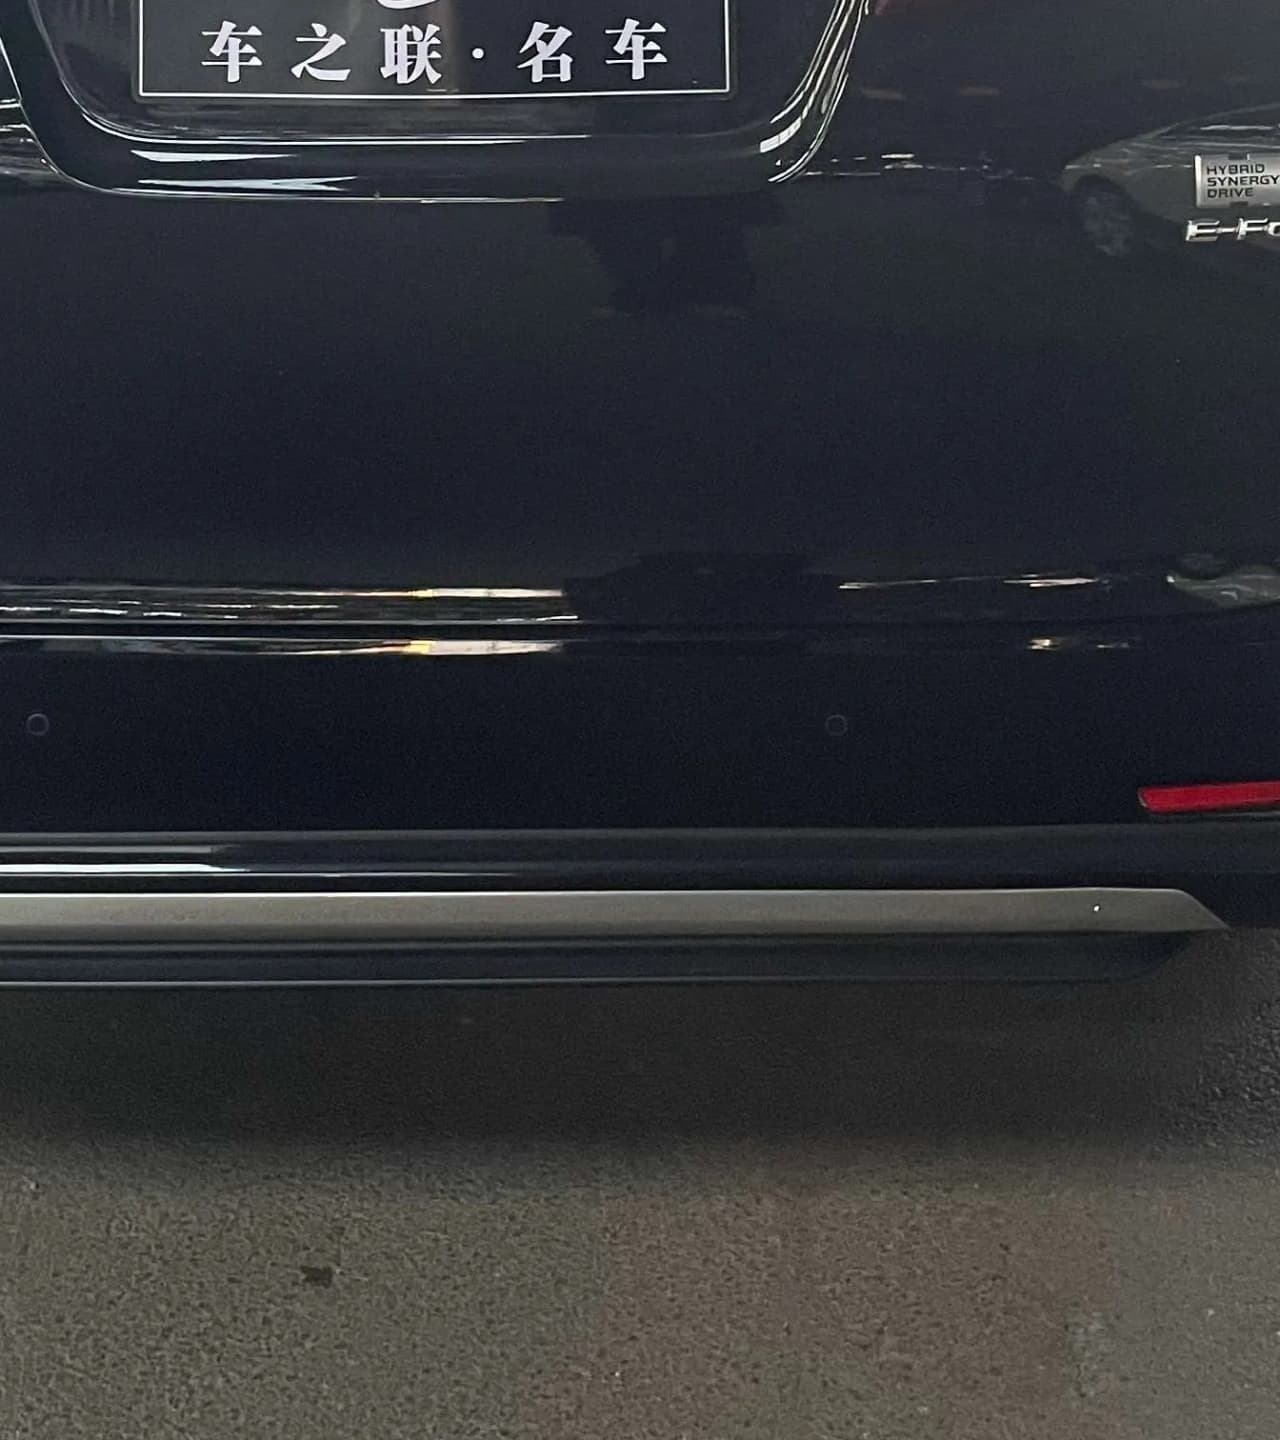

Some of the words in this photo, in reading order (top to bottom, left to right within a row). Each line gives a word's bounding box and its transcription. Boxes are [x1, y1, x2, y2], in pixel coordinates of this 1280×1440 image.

[1206, 163, 1265, 175] HYBRID
[1207, 175, 1280, 187] SYNERGY
[1207, 187, 1254, 198] DRIVE
